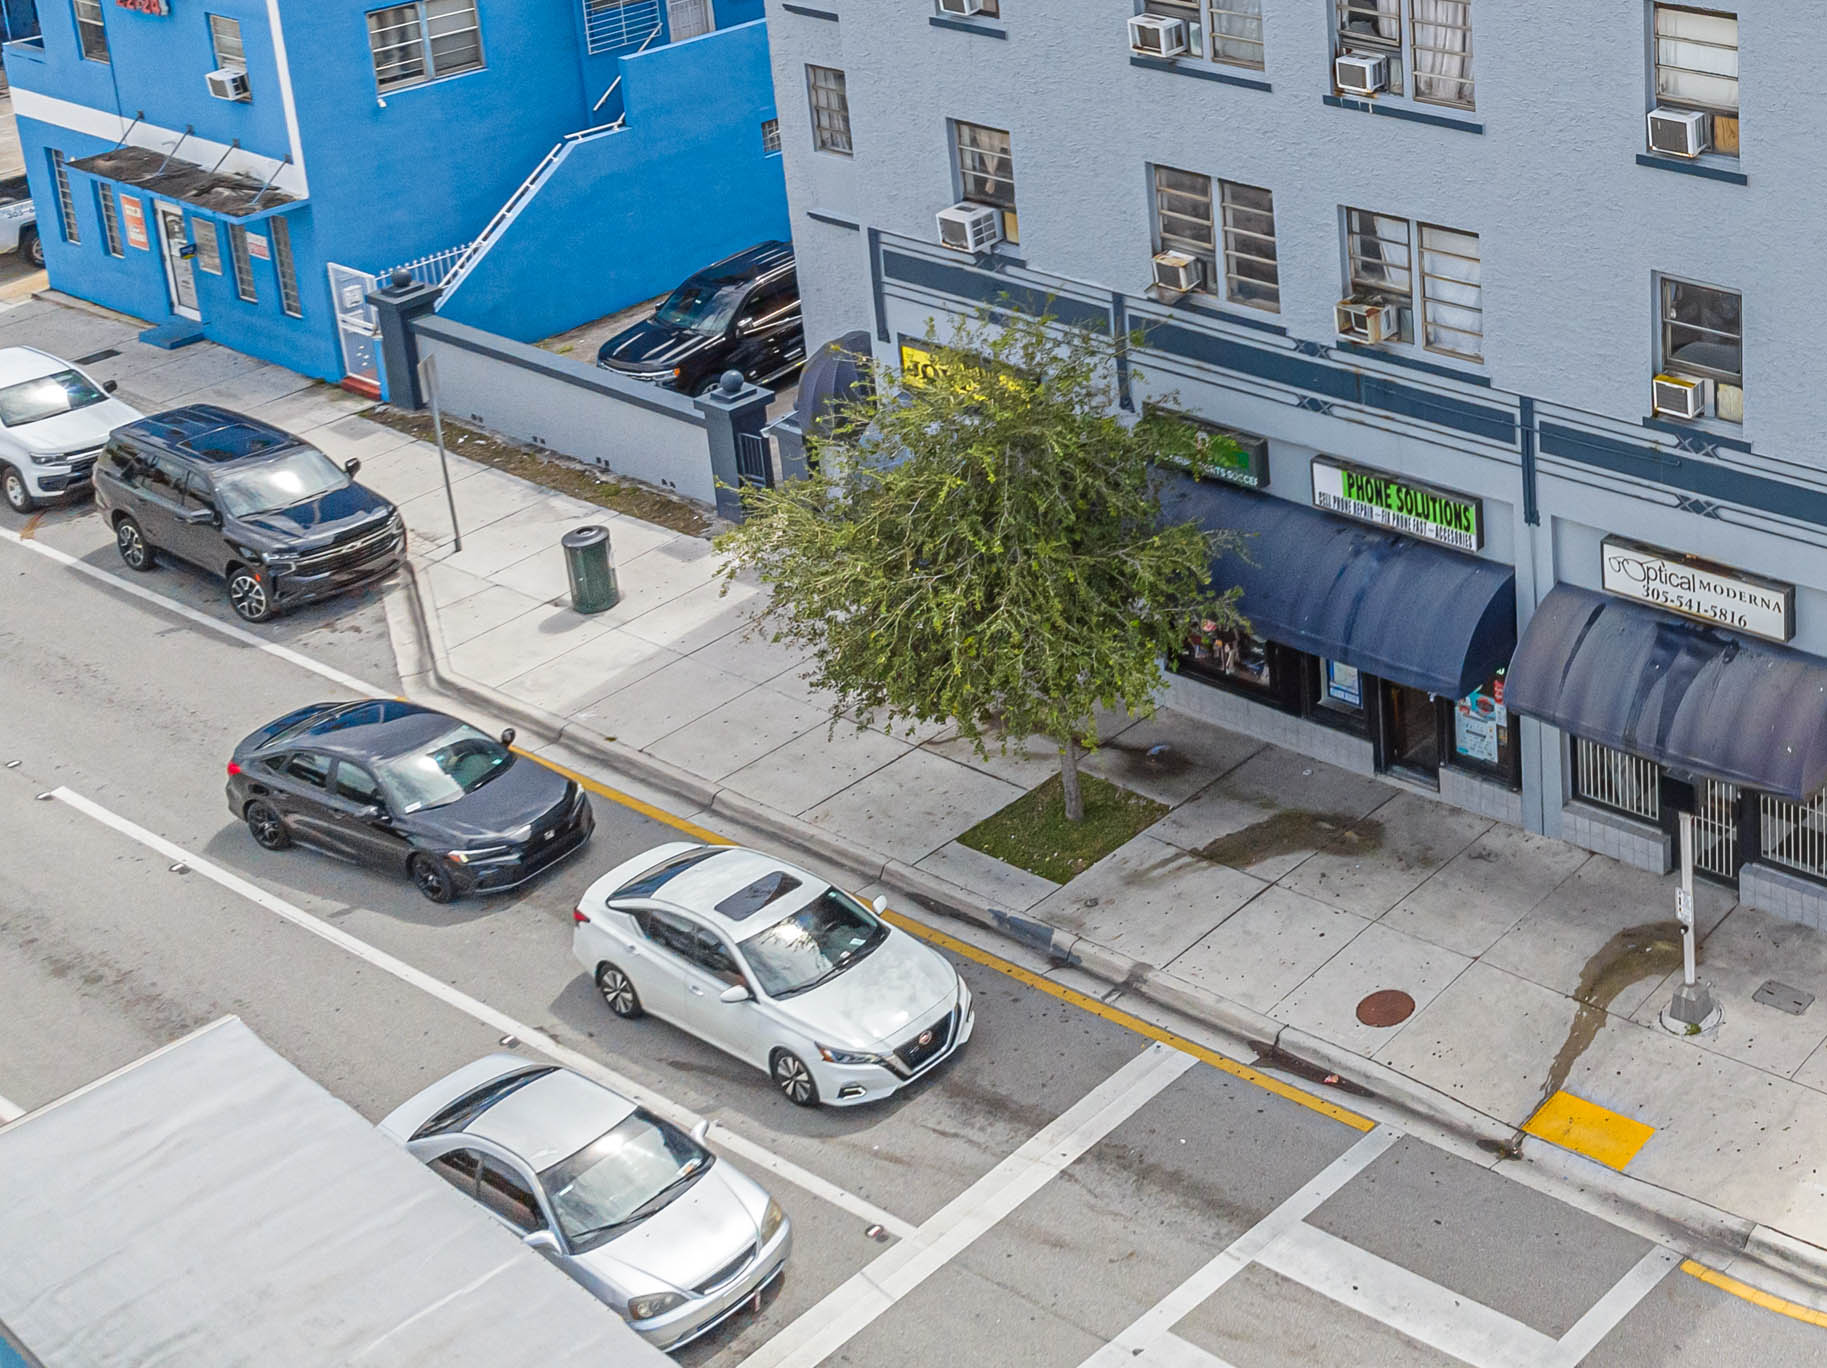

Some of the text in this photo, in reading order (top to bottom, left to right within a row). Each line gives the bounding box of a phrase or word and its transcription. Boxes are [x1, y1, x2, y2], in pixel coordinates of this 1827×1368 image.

[1318, 491, 1332, 508] CELL
[1333, 495, 1352, 514] PHONE
[1353, 501, 1374, 520] REPAIR
[1381, 508, 1391, 524] FIX
[1392, 512, 1412, 532] PHONE
[1412, 517, 1427, 537] FAST
[1346, 471, 1472, 533] PHONE SOLUTIONS
[1621, 558, 1783, 614] Optical MODERNA
[1641, 584, 1749, 629] 305-541-5816
